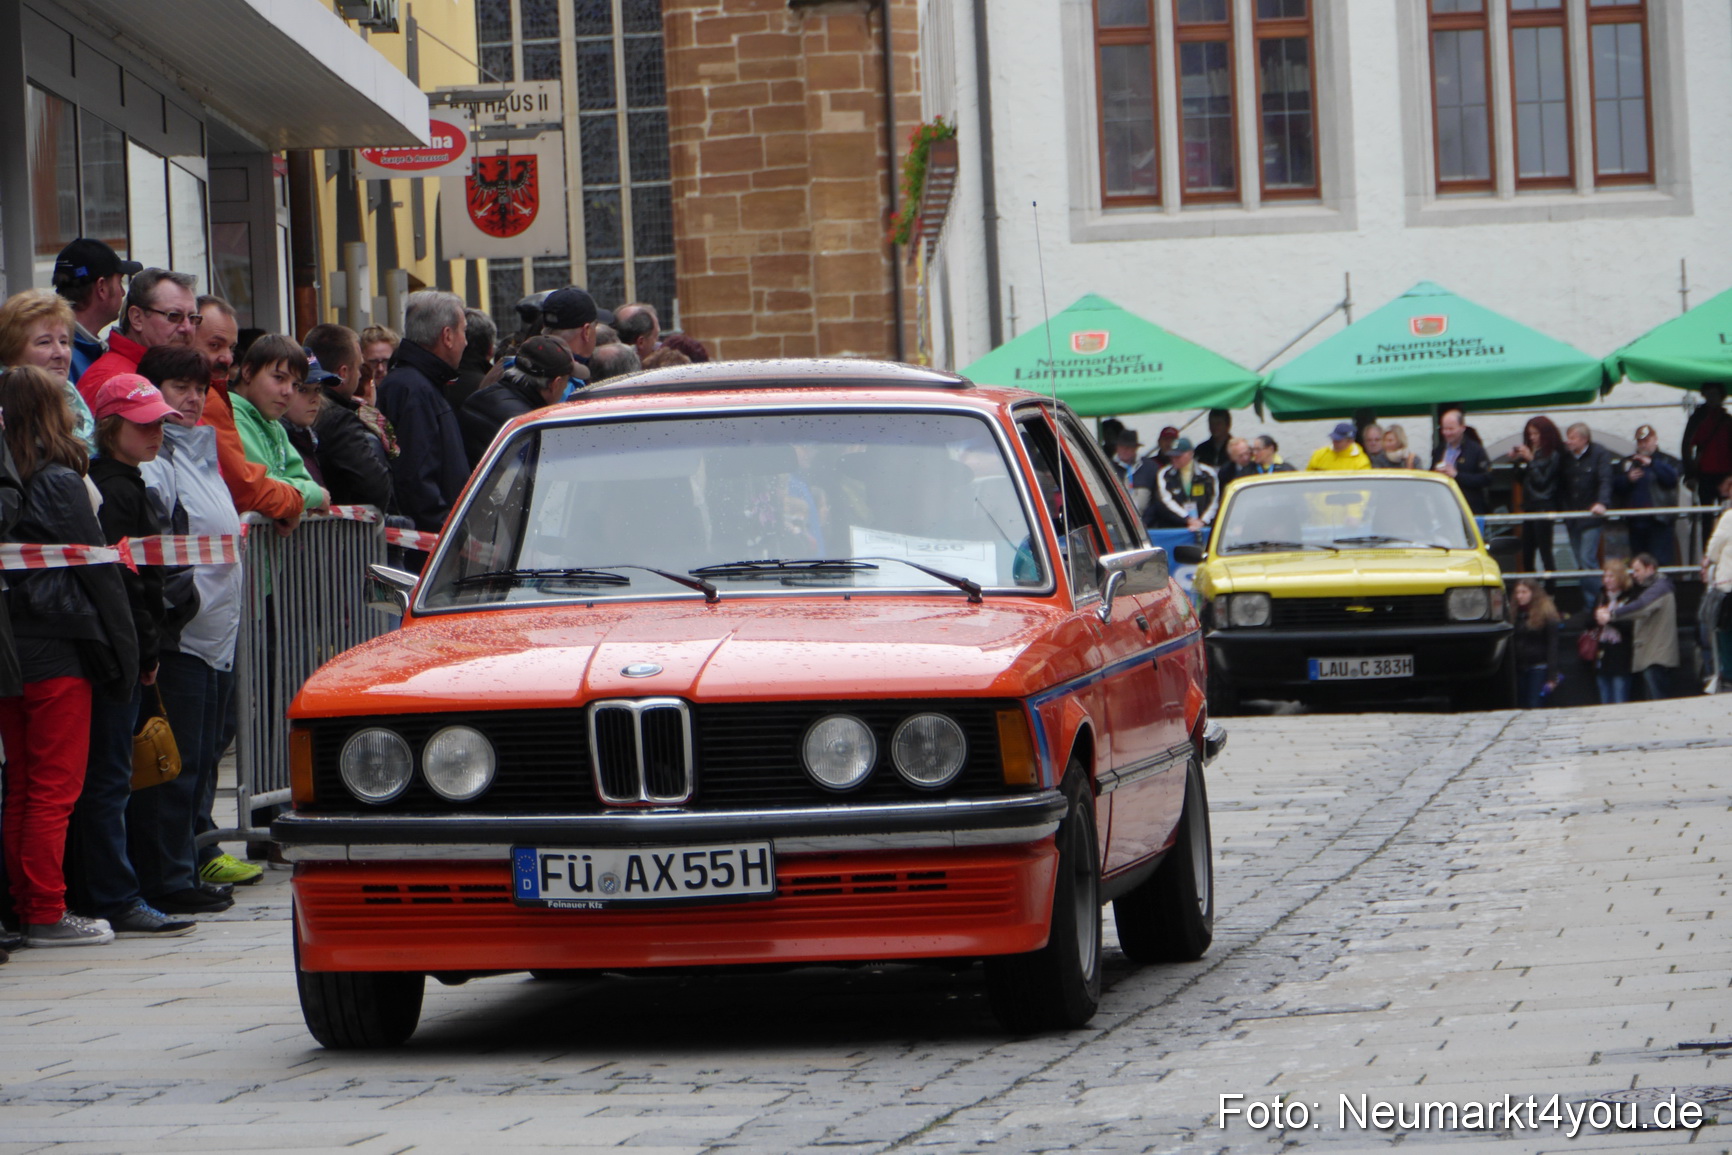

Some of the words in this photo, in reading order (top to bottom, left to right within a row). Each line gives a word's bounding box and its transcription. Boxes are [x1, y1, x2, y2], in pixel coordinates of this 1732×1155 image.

[538, 93, 548, 111] II
[1376, 337, 1484, 352] Neumarkter
[1036, 353, 1144, 367] Neumarkter
[1355, 345, 1505, 366] Lammsbräu
[1014, 360, 1164, 381] Lammsbräu
[1319, 661, 1348, 677] LAU
[1360, 661, 1370, 676] C
[1373, 658, 1412, 676] 383H
[523, 879, 532, 890] D
[588, 901, 604, 910] Kfz
